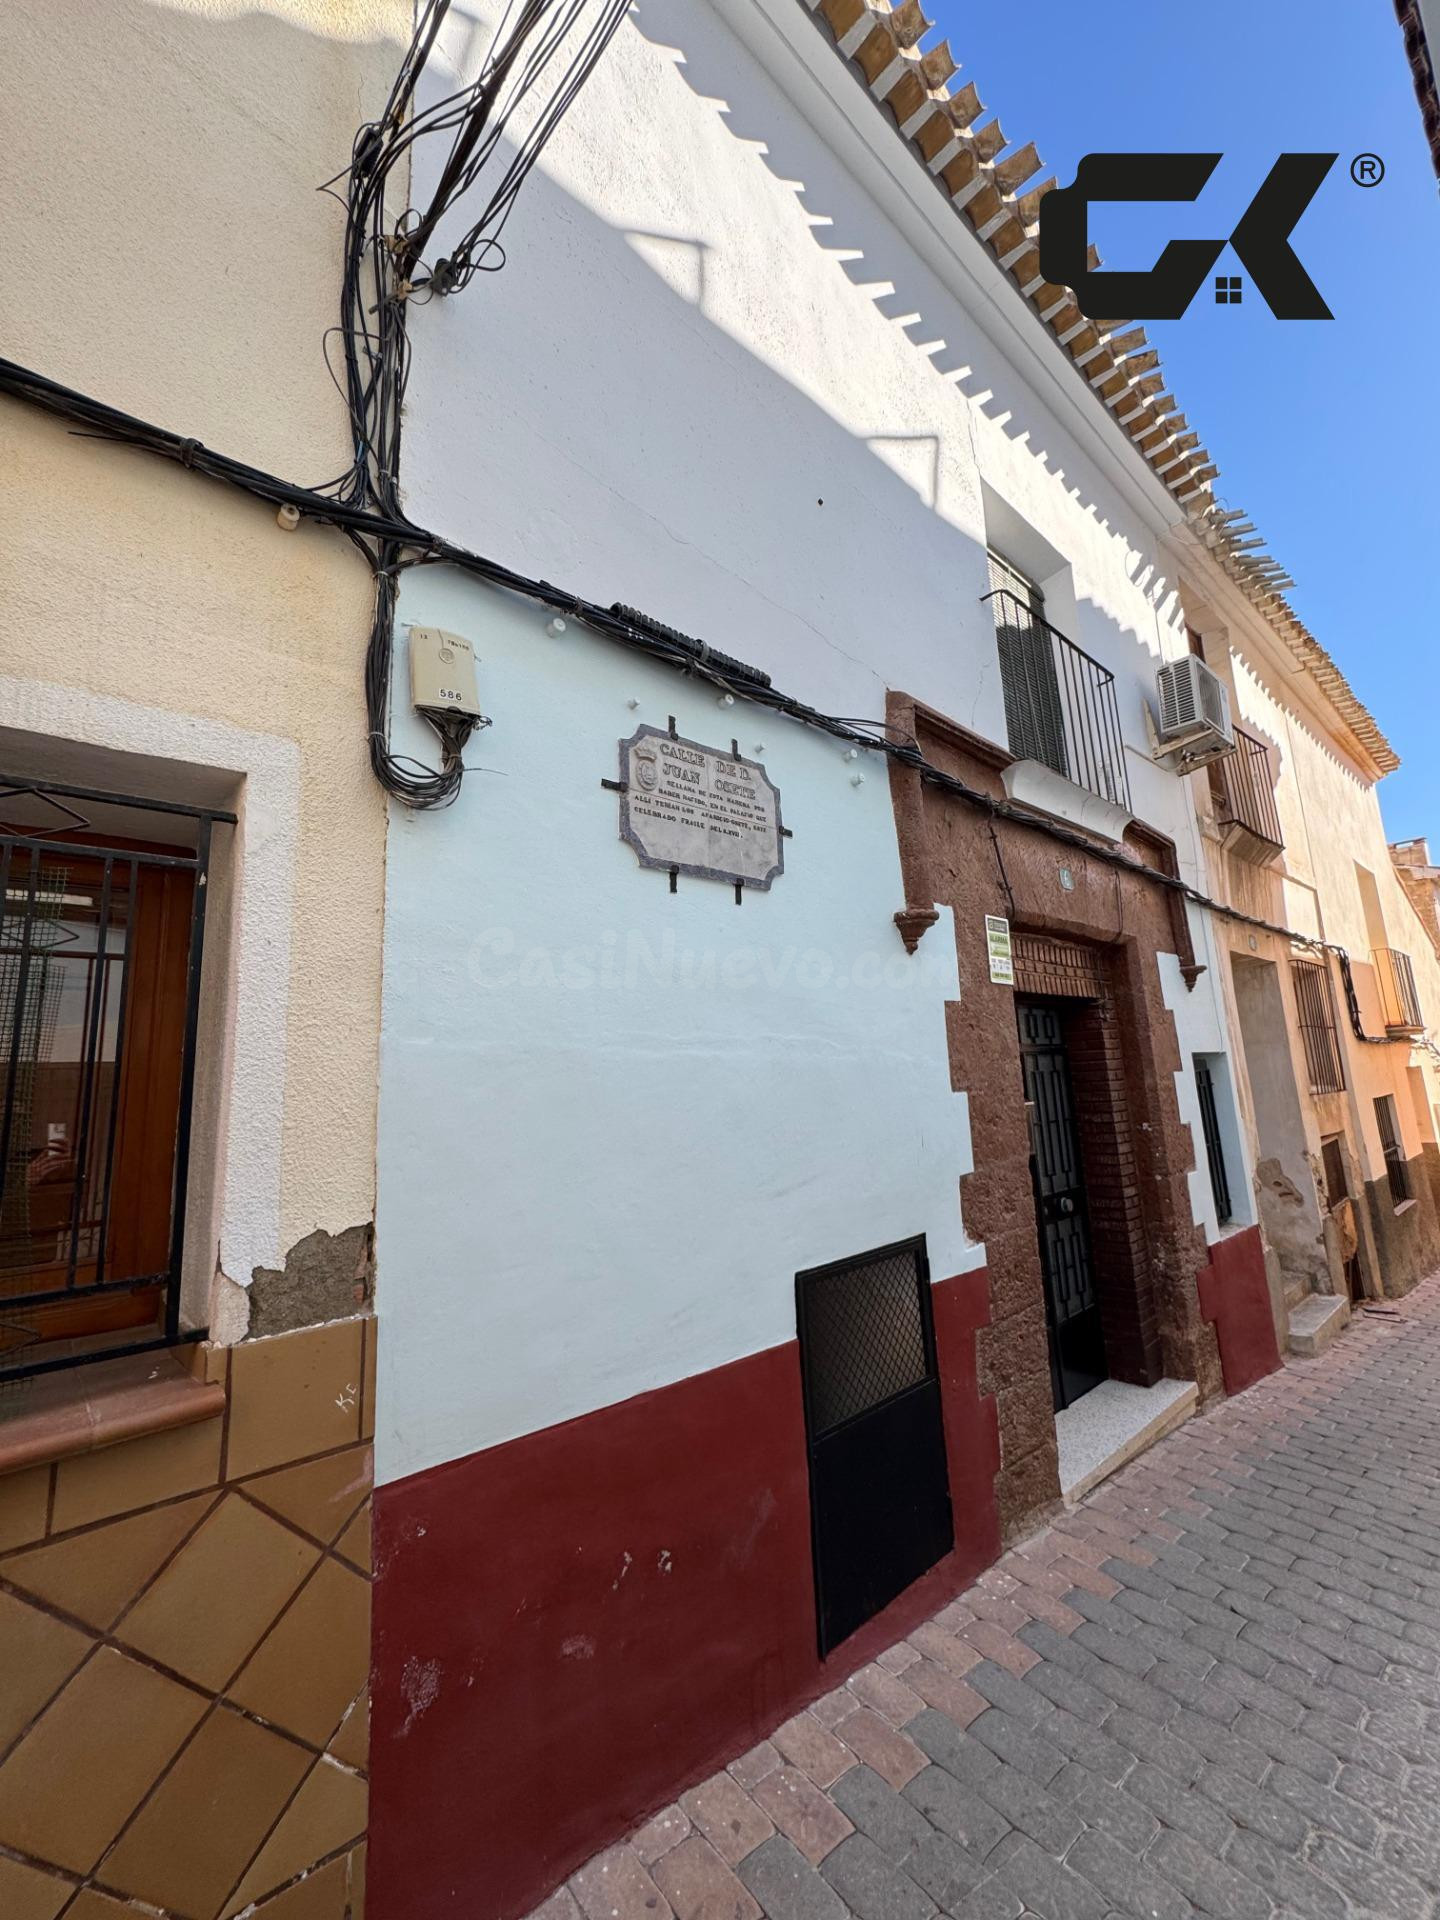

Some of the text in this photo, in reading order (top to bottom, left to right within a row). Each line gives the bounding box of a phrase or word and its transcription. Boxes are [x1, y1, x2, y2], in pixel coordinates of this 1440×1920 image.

[440, 689, 462, 701] 586
[660, 743, 706, 767] CALLE
[716, 761, 737, 777] DE
[662, 762, 701, 784] JUAN
[634, 806, 677, 822] CELEBRADO
[681, 817, 706, 829] FRAILE
